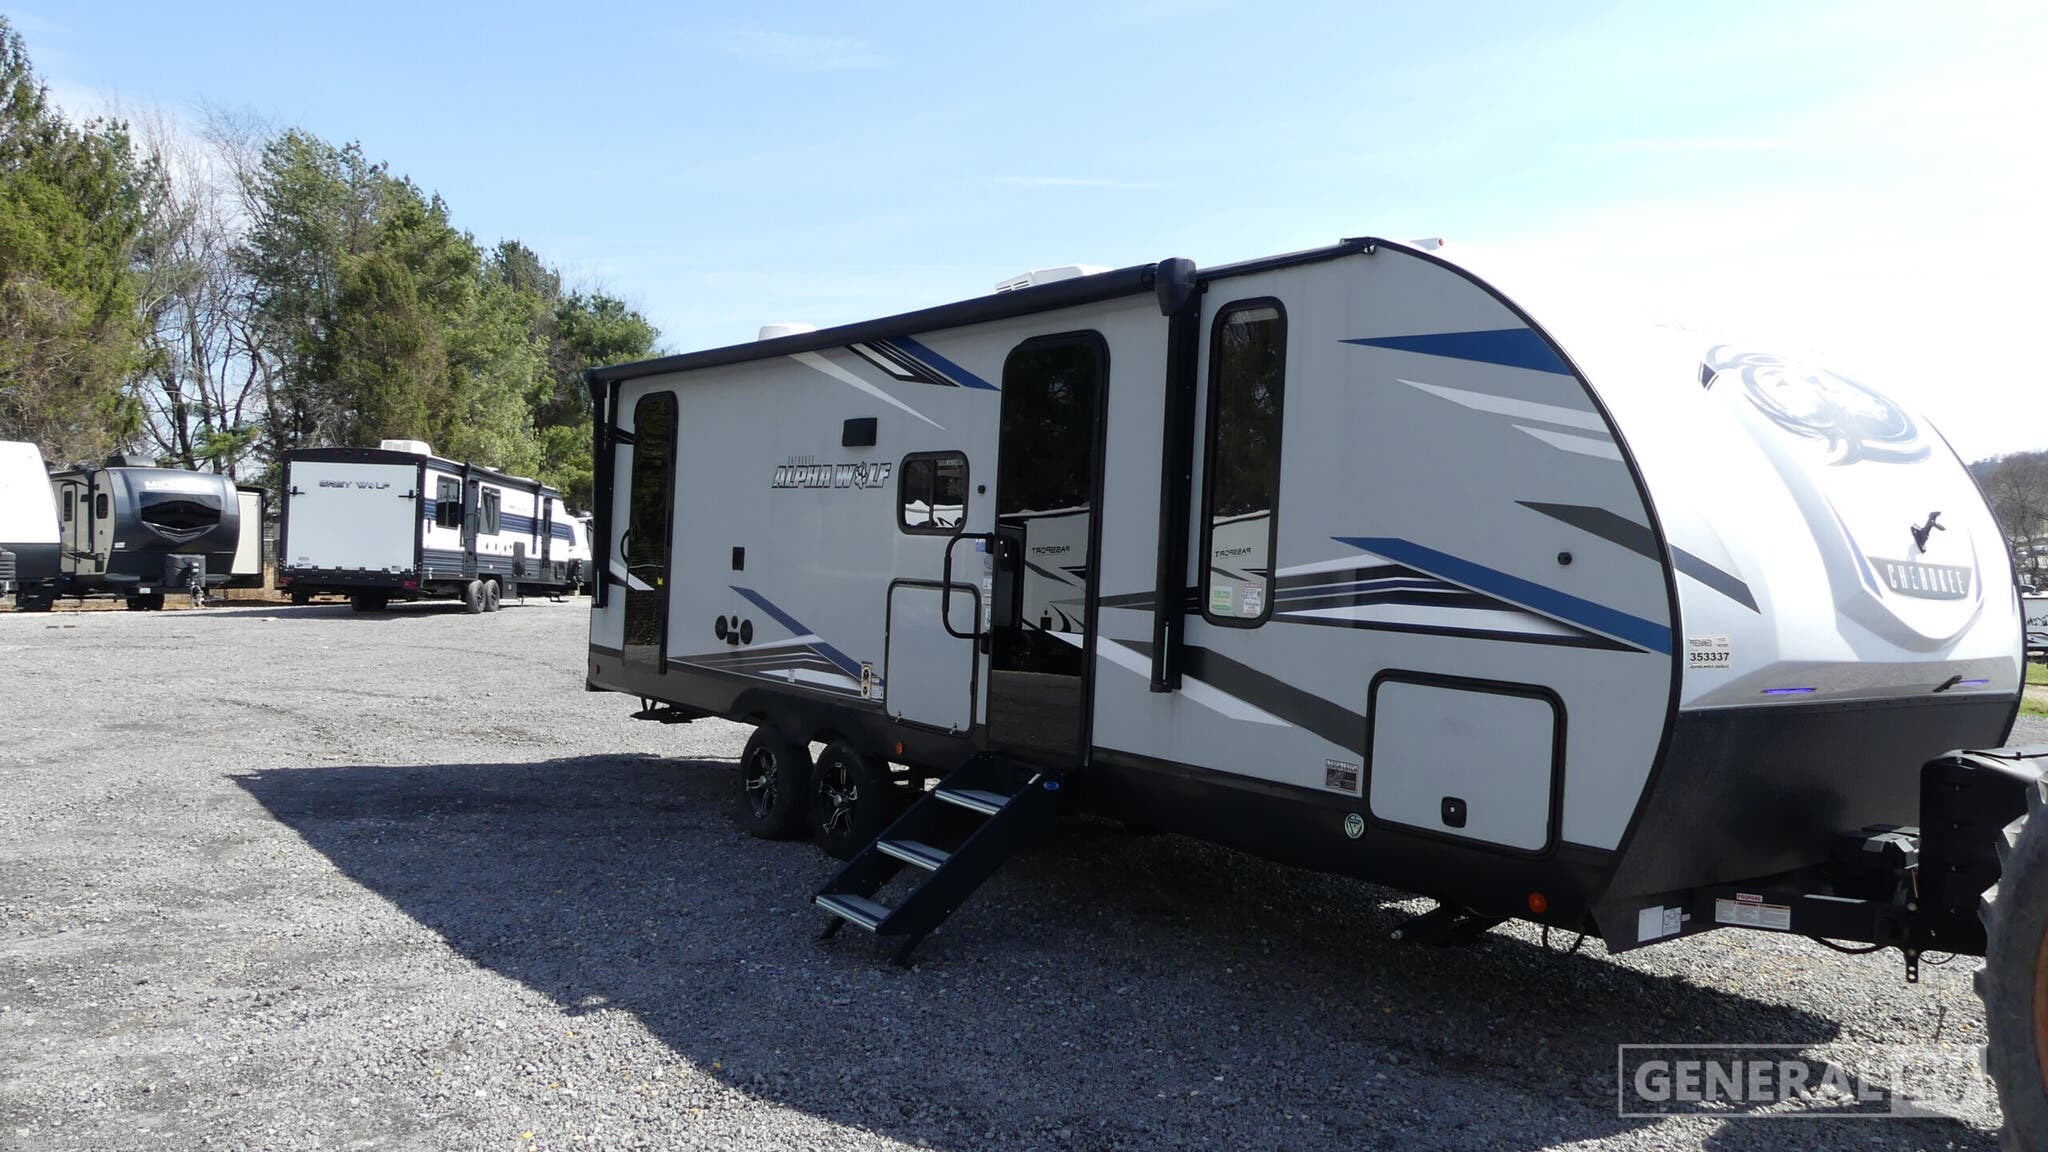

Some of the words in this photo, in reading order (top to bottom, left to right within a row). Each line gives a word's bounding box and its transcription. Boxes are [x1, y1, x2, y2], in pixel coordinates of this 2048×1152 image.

[319, 480, 352, 489] GREY
[772, 465, 832, 489] ALPHA
[835, 461, 892, 490] WOLF
[1887, 564, 1966, 594] CHEROKEE
[1689, 652, 1729, 662] 353337
